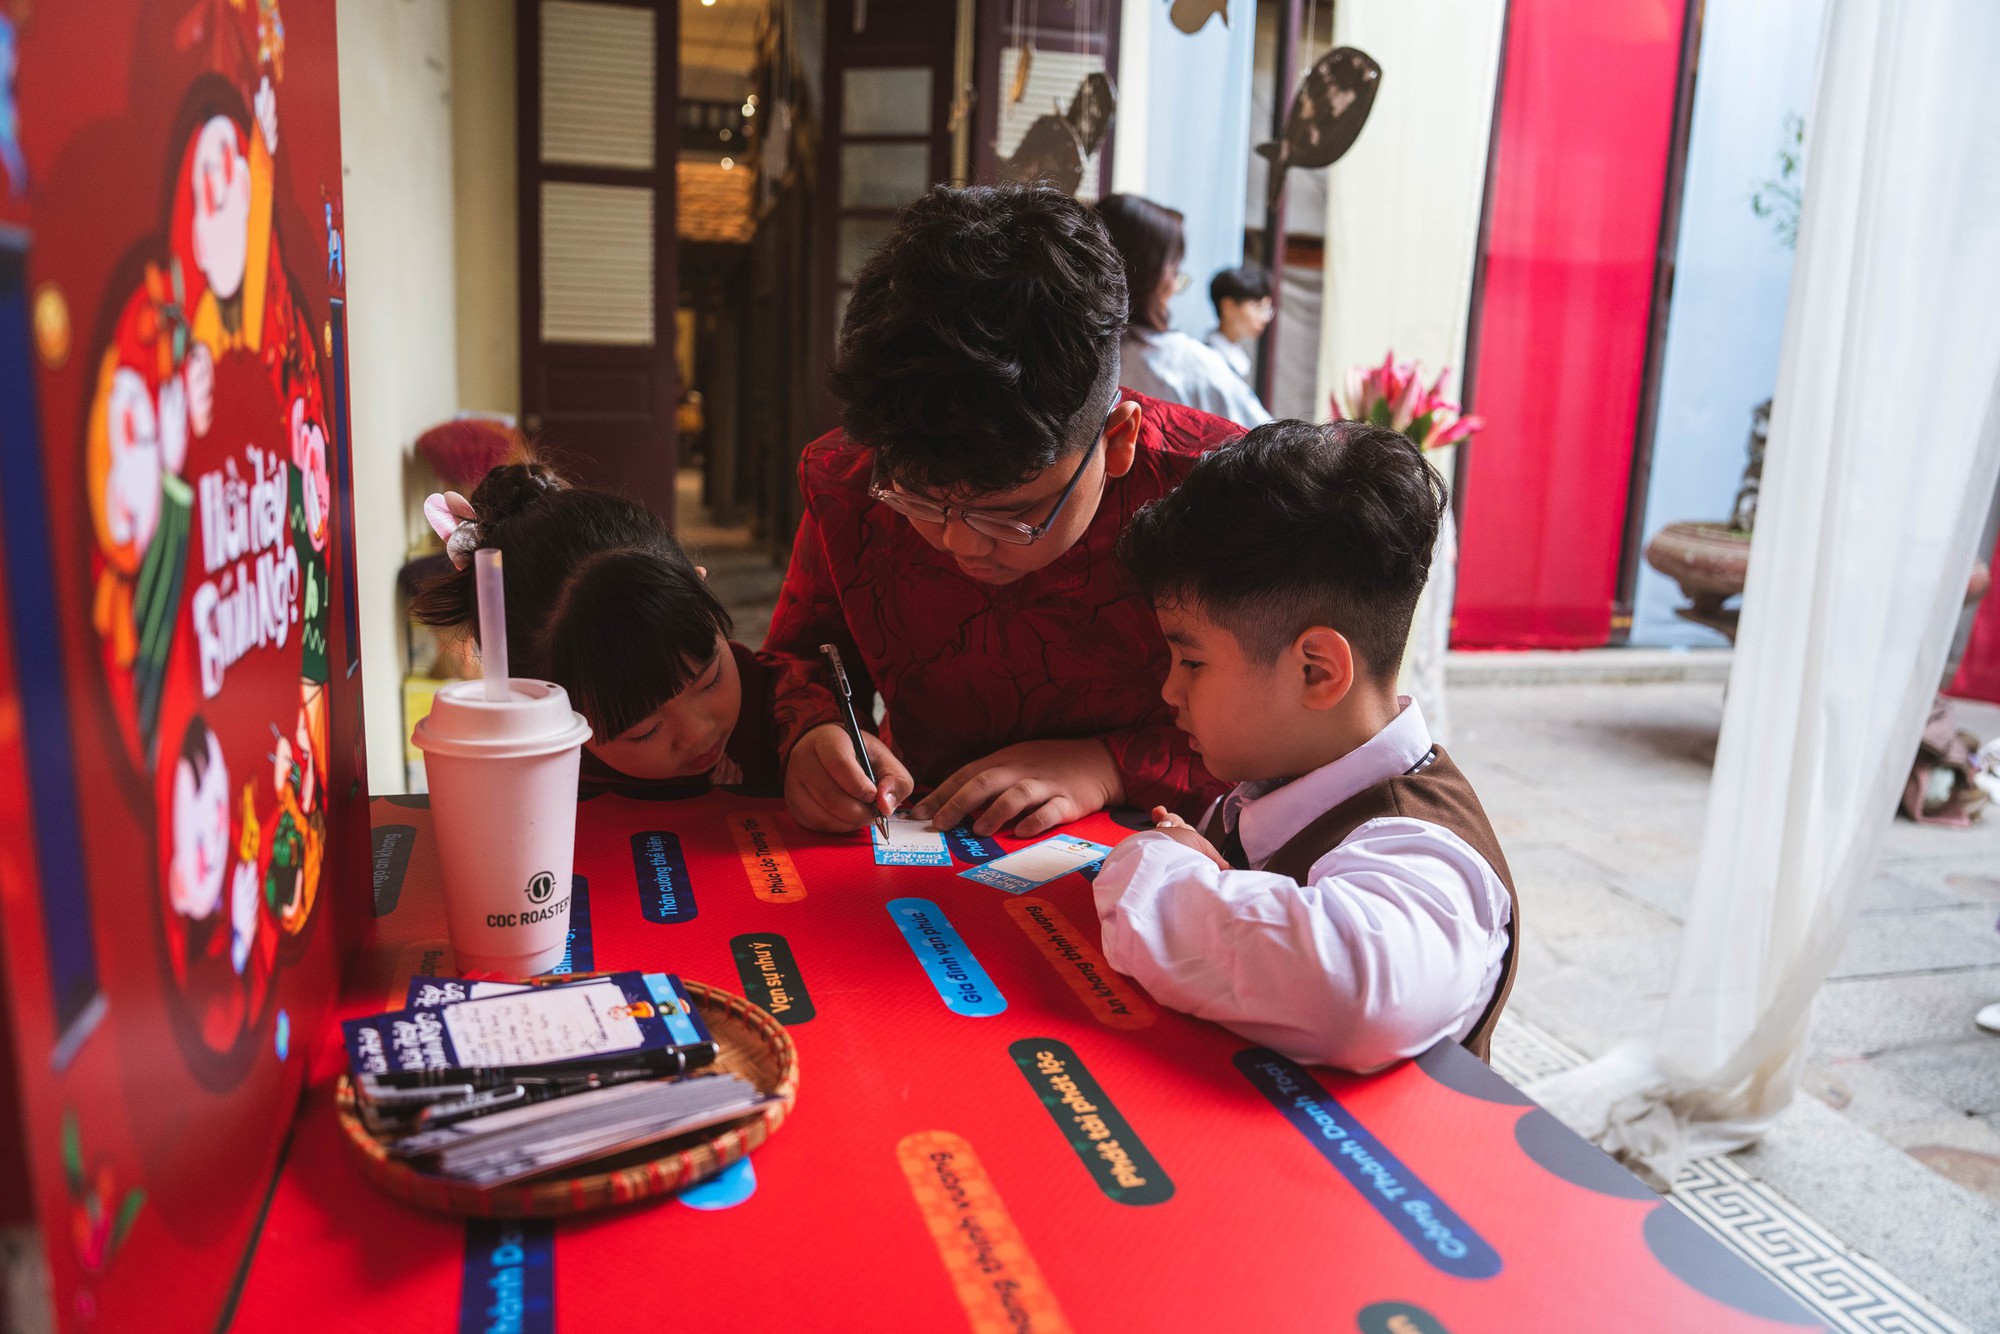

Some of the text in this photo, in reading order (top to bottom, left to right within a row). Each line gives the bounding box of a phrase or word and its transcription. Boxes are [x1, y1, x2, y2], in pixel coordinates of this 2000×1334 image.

[645, 836, 678, 917] Thân cường thể kiện
[760, 858, 780, 872] Lộc
[766, 873, 788, 894] Phúc
[486, 914, 517, 928] COC
[911, 912, 983, 1004] Gia đình vạn phúc
[1025, 905, 1132, 1015] An khang thịnh vượng
[749, 942, 794, 1014] Vạn sự như ý
[1036, 1051, 1147, 1188] Phát tài phát lộc
[1255, 1062, 1468, 1259] Công Thành Danh Toại
